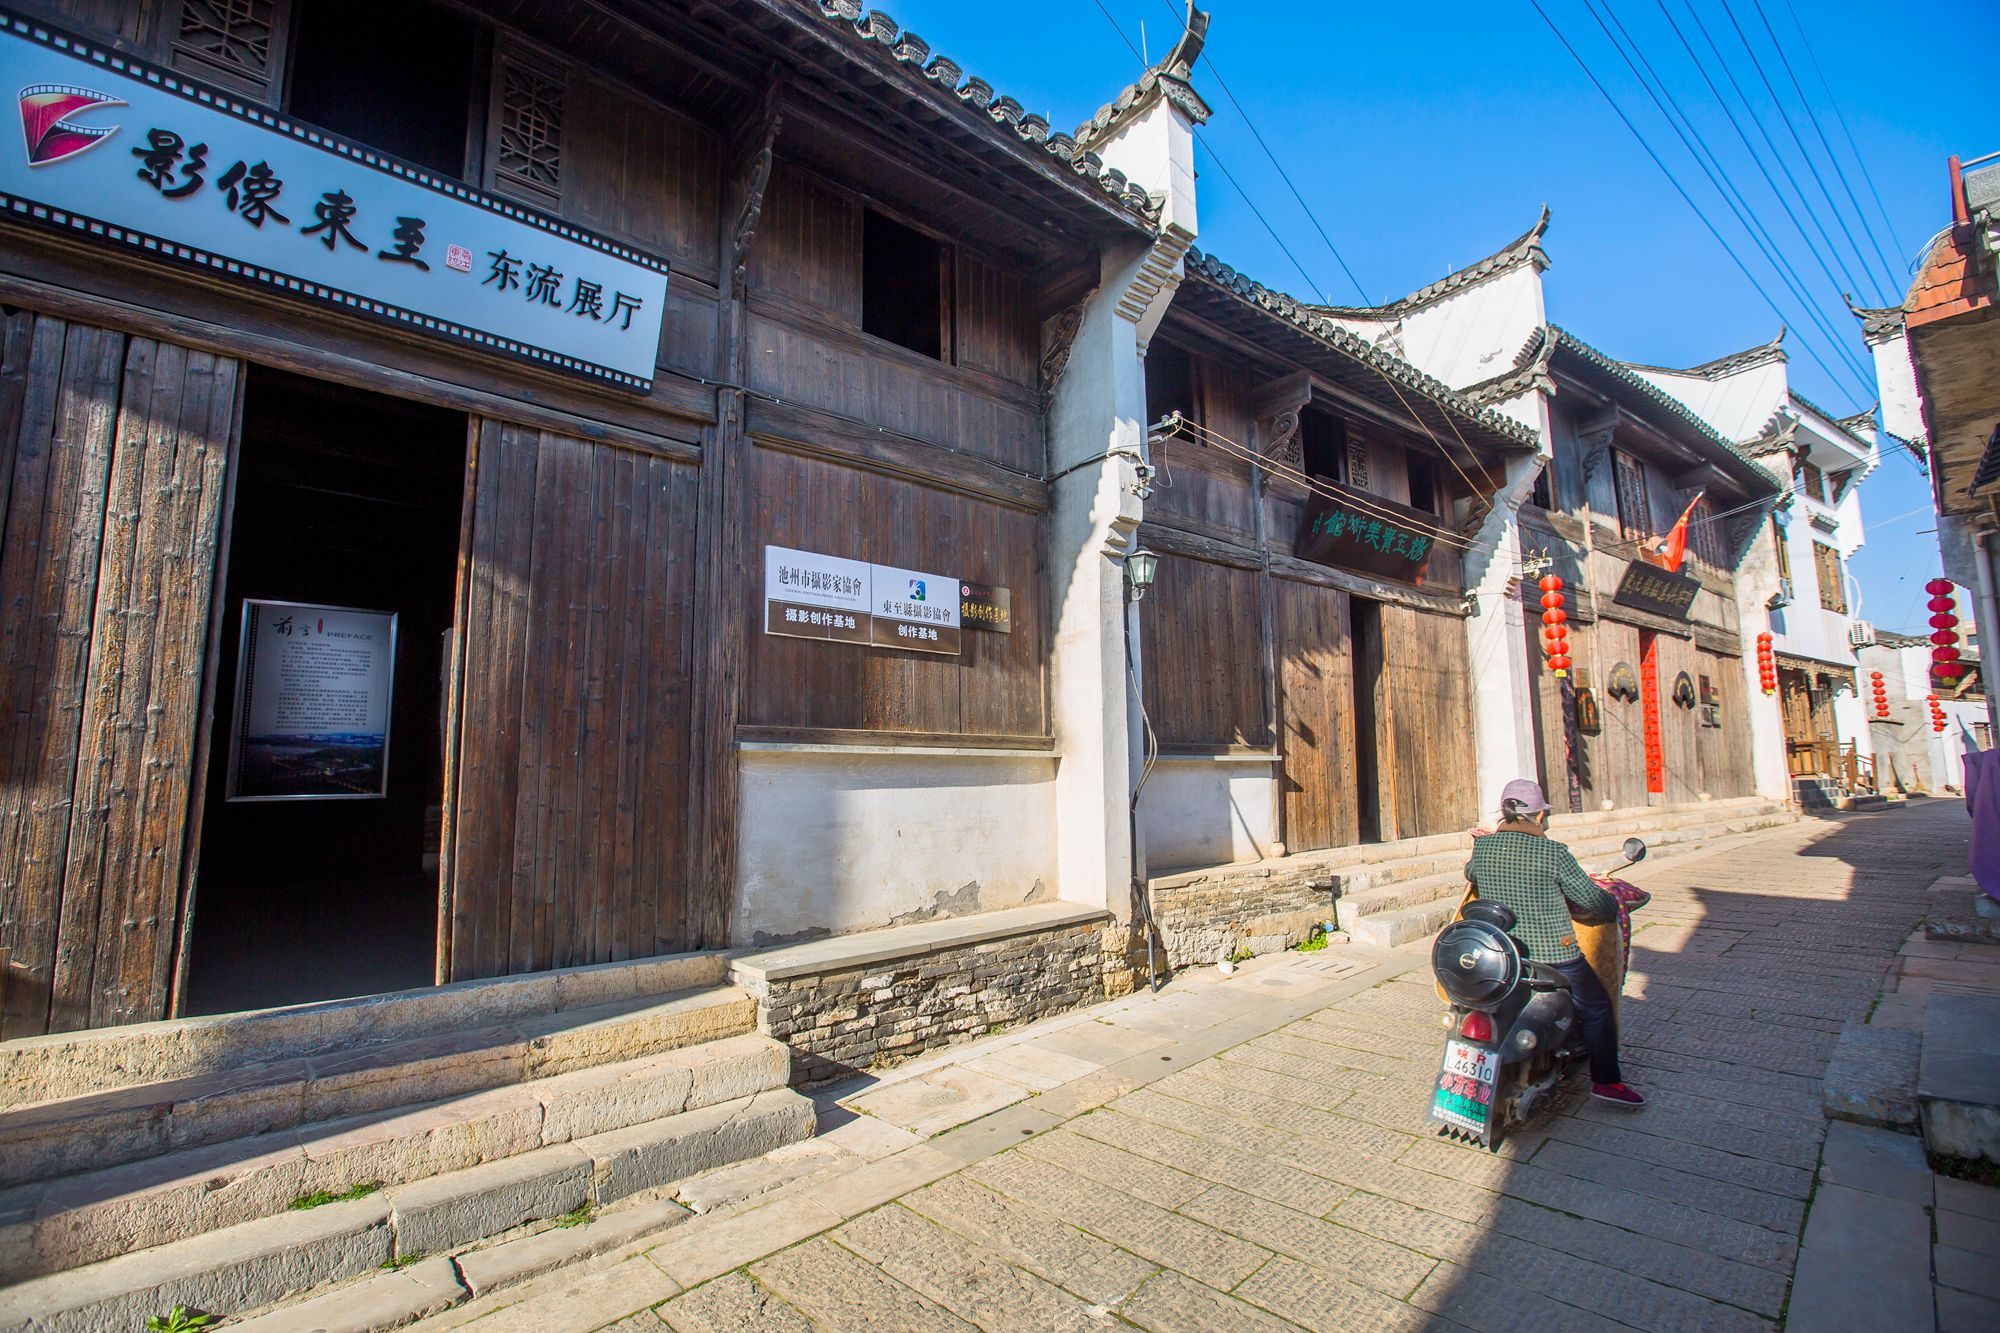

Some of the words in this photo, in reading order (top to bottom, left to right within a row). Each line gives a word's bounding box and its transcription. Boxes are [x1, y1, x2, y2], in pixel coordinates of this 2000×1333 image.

[132, 127, 430, 271] 影像東至
[481, 249, 643, 331] 东流展厅
[779, 565, 862, 597] 池州市攝影家協會
[272, 616, 312, 637] 前言
[327, 631, 374, 641] PREFACE
[785, 607, 856, 629] 摄影创作基地
[898, 624, 938, 641] 创作基地
[1476, 1054, 1487, 1065] R
[1440, 1071, 1492, 1106] 小方车业
